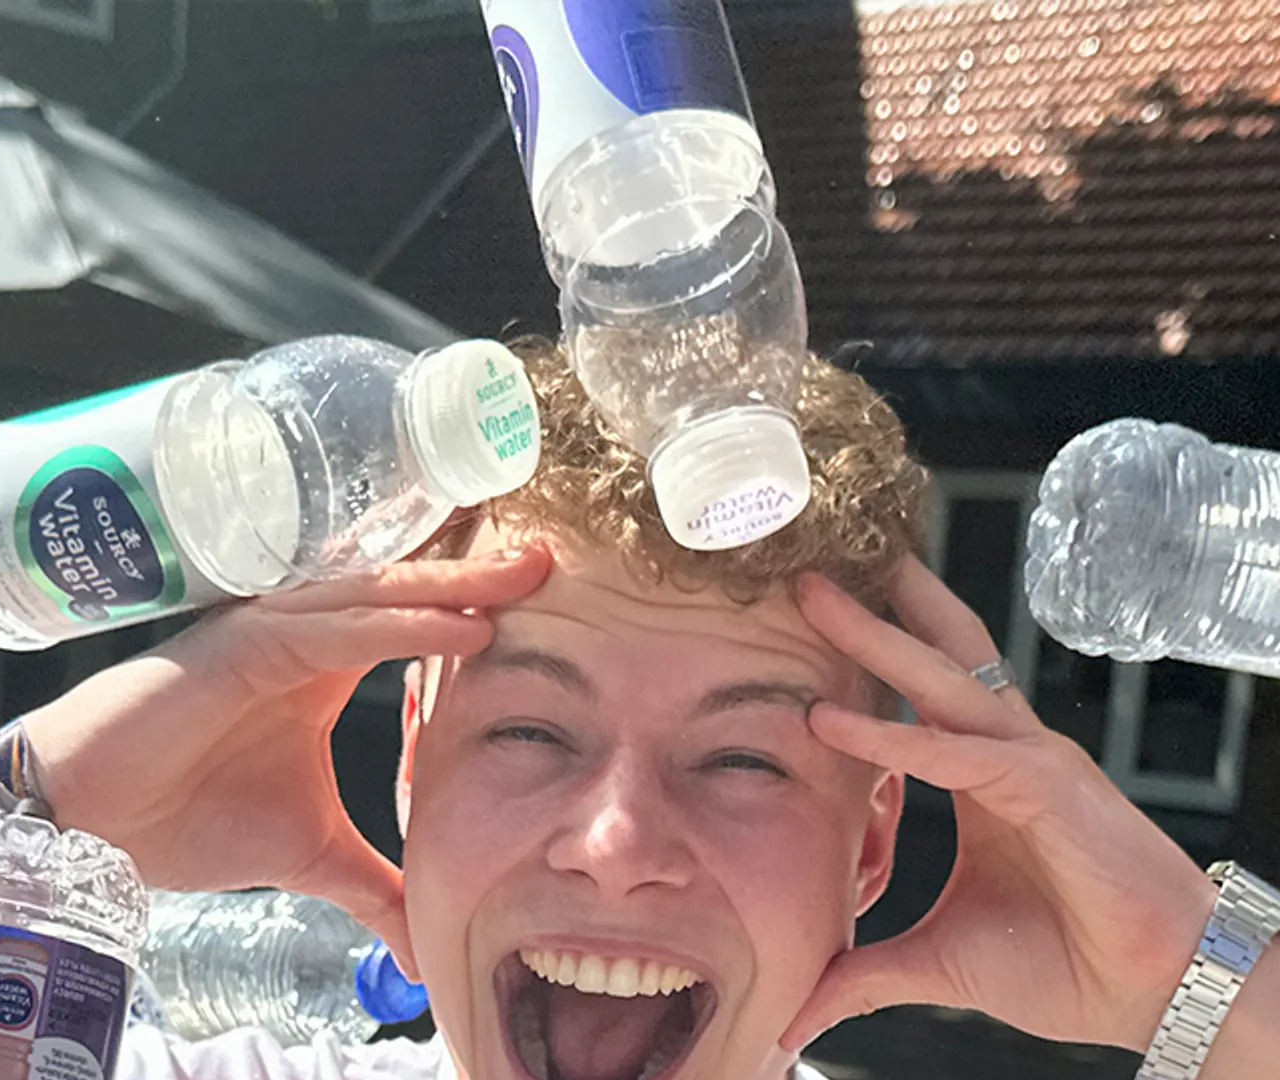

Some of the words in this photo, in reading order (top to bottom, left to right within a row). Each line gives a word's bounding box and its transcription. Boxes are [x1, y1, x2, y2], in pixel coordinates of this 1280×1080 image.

[477, 400, 535, 443] Vitamin
[493, 427, 532, 462] water
[37, 511, 92, 593] water
[53, 486, 119, 601] Vitamin
[92, 495, 146, 581] SOURCY
